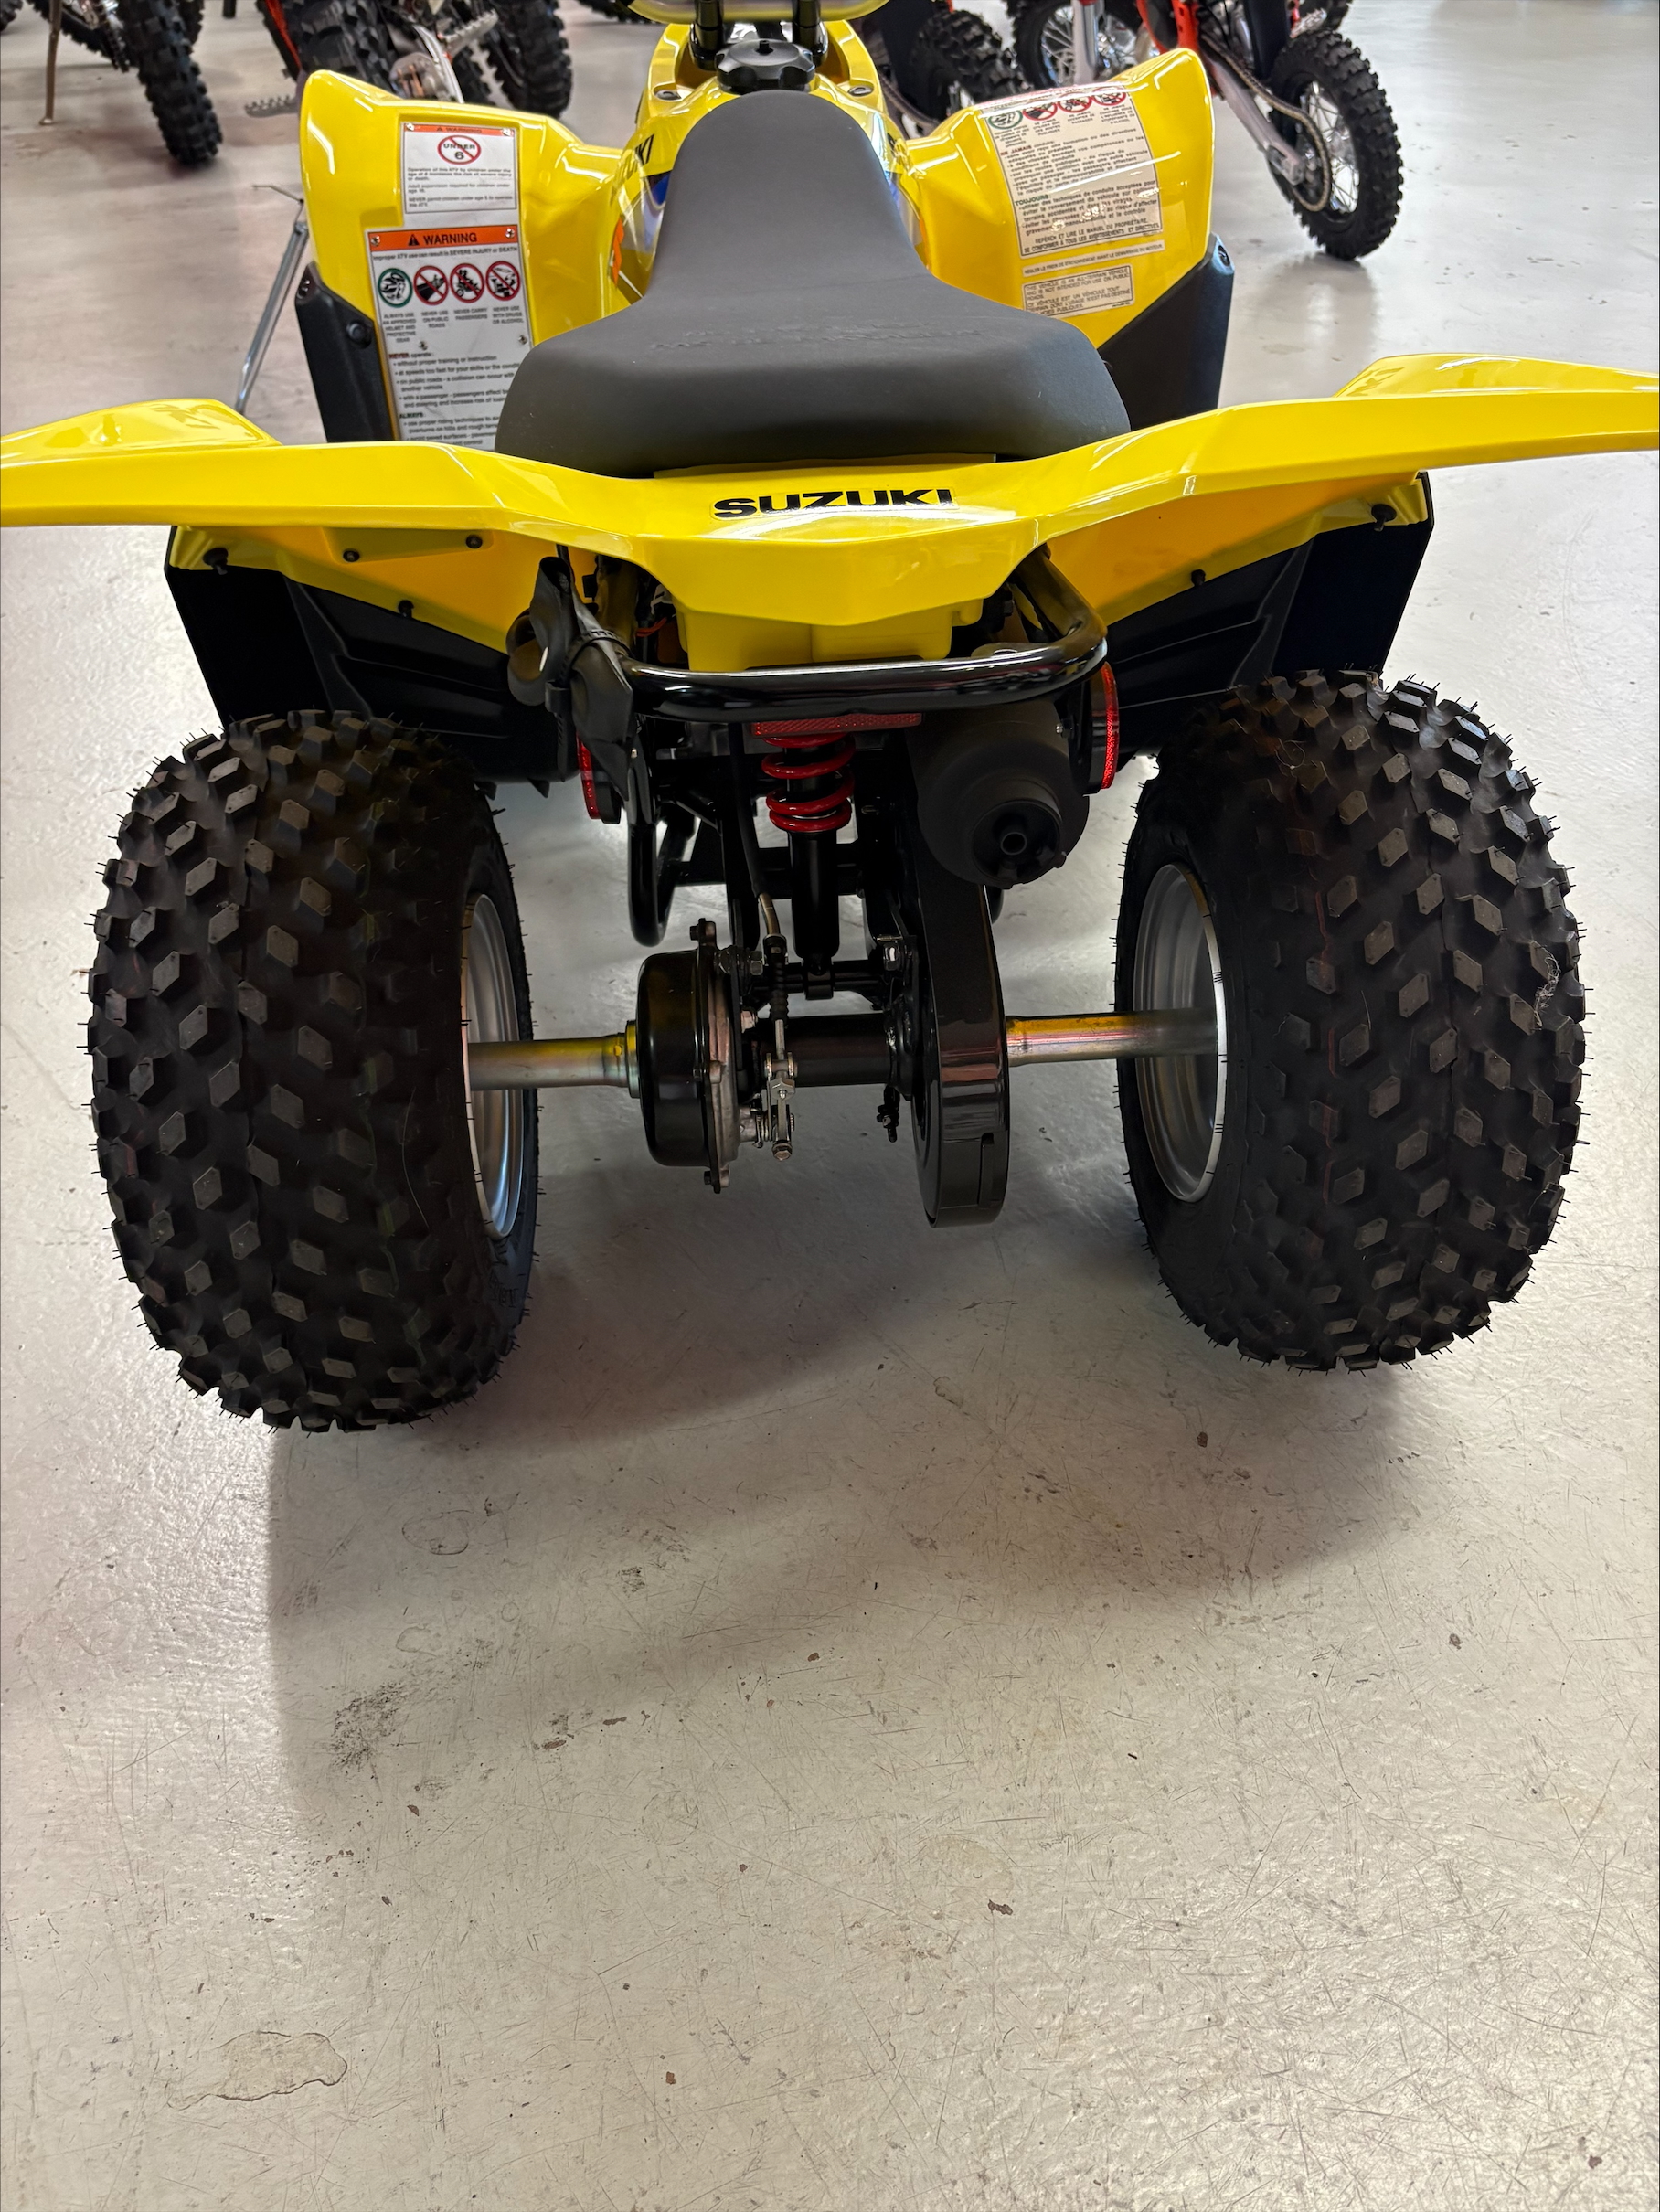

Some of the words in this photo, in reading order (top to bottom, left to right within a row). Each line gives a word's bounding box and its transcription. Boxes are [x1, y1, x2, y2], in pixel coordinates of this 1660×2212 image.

[454, 152, 464, 160] 6
[423, 232, 477, 245] WARNING
[714, 489, 953, 517] SUZUKI
